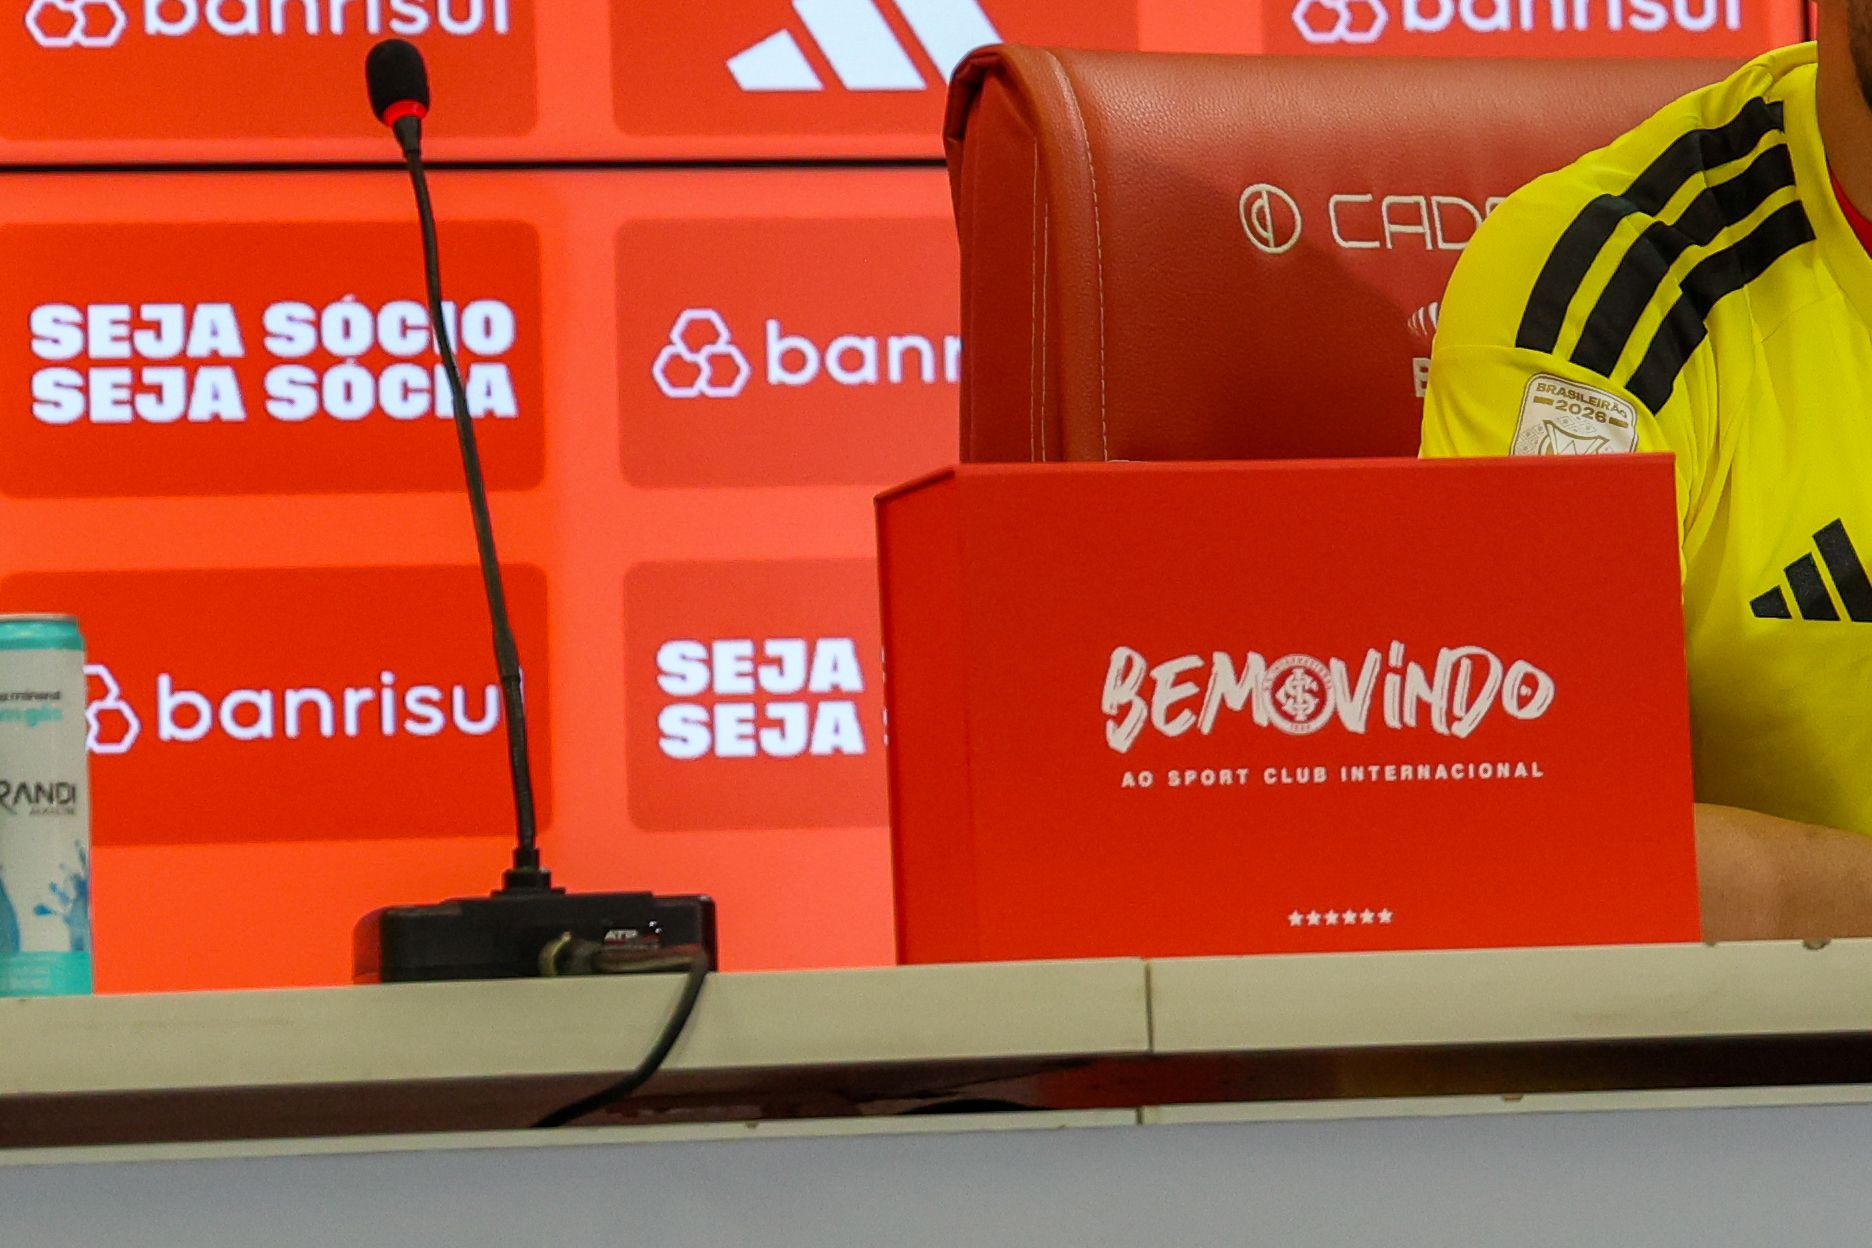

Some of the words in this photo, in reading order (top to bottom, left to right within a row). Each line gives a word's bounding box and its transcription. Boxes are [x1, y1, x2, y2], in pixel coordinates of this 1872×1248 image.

[30, 303, 245, 361] SEJA
[263, 295, 515, 359] SÓCIO
[766, 320, 961, 385] banr
[32, 366, 247, 424] SEJA
[264, 359, 518, 421] SÓCIA
[1555, 399, 1607, 424] 2026
[657, 638, 864, 696] SEJA
[158, 668, 523, 741] banrisu
[658, 700, 866, 759] SEJA
[0, 780, 76, 815] RANDI
[1122, 771, 1153, 787] AO
[1168, 769, 1248, 786] SPORT
[1264, 767, 1327, 784] CLUB
[1341, 762, 1543, 781] INTERNACIONAL
